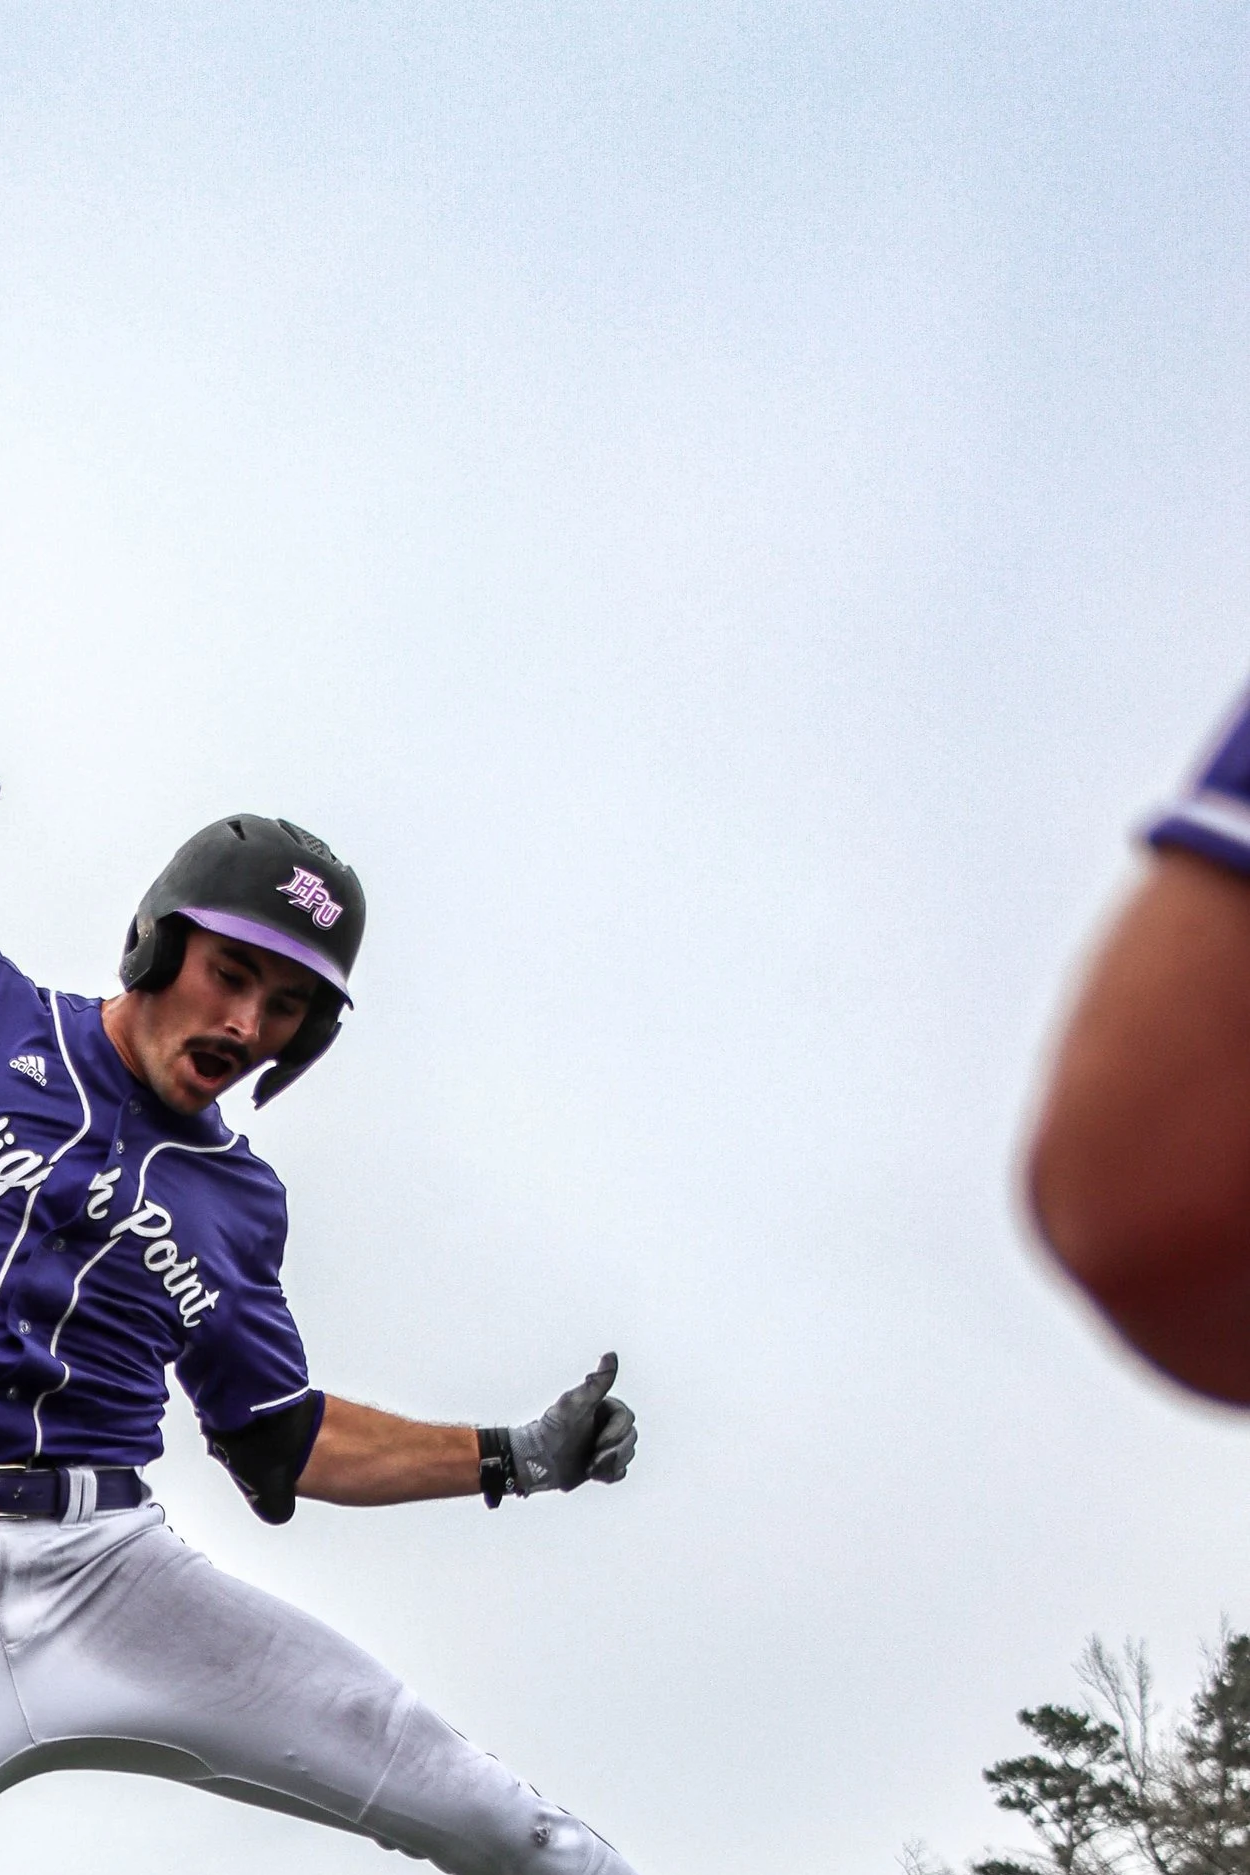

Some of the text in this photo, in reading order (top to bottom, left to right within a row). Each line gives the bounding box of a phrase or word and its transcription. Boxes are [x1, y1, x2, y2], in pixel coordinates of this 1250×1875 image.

[276, 866, 343, 931] HPU
[9, 1058, 48, 1087] adidas
[110, 1199, 220, 1328] Point
